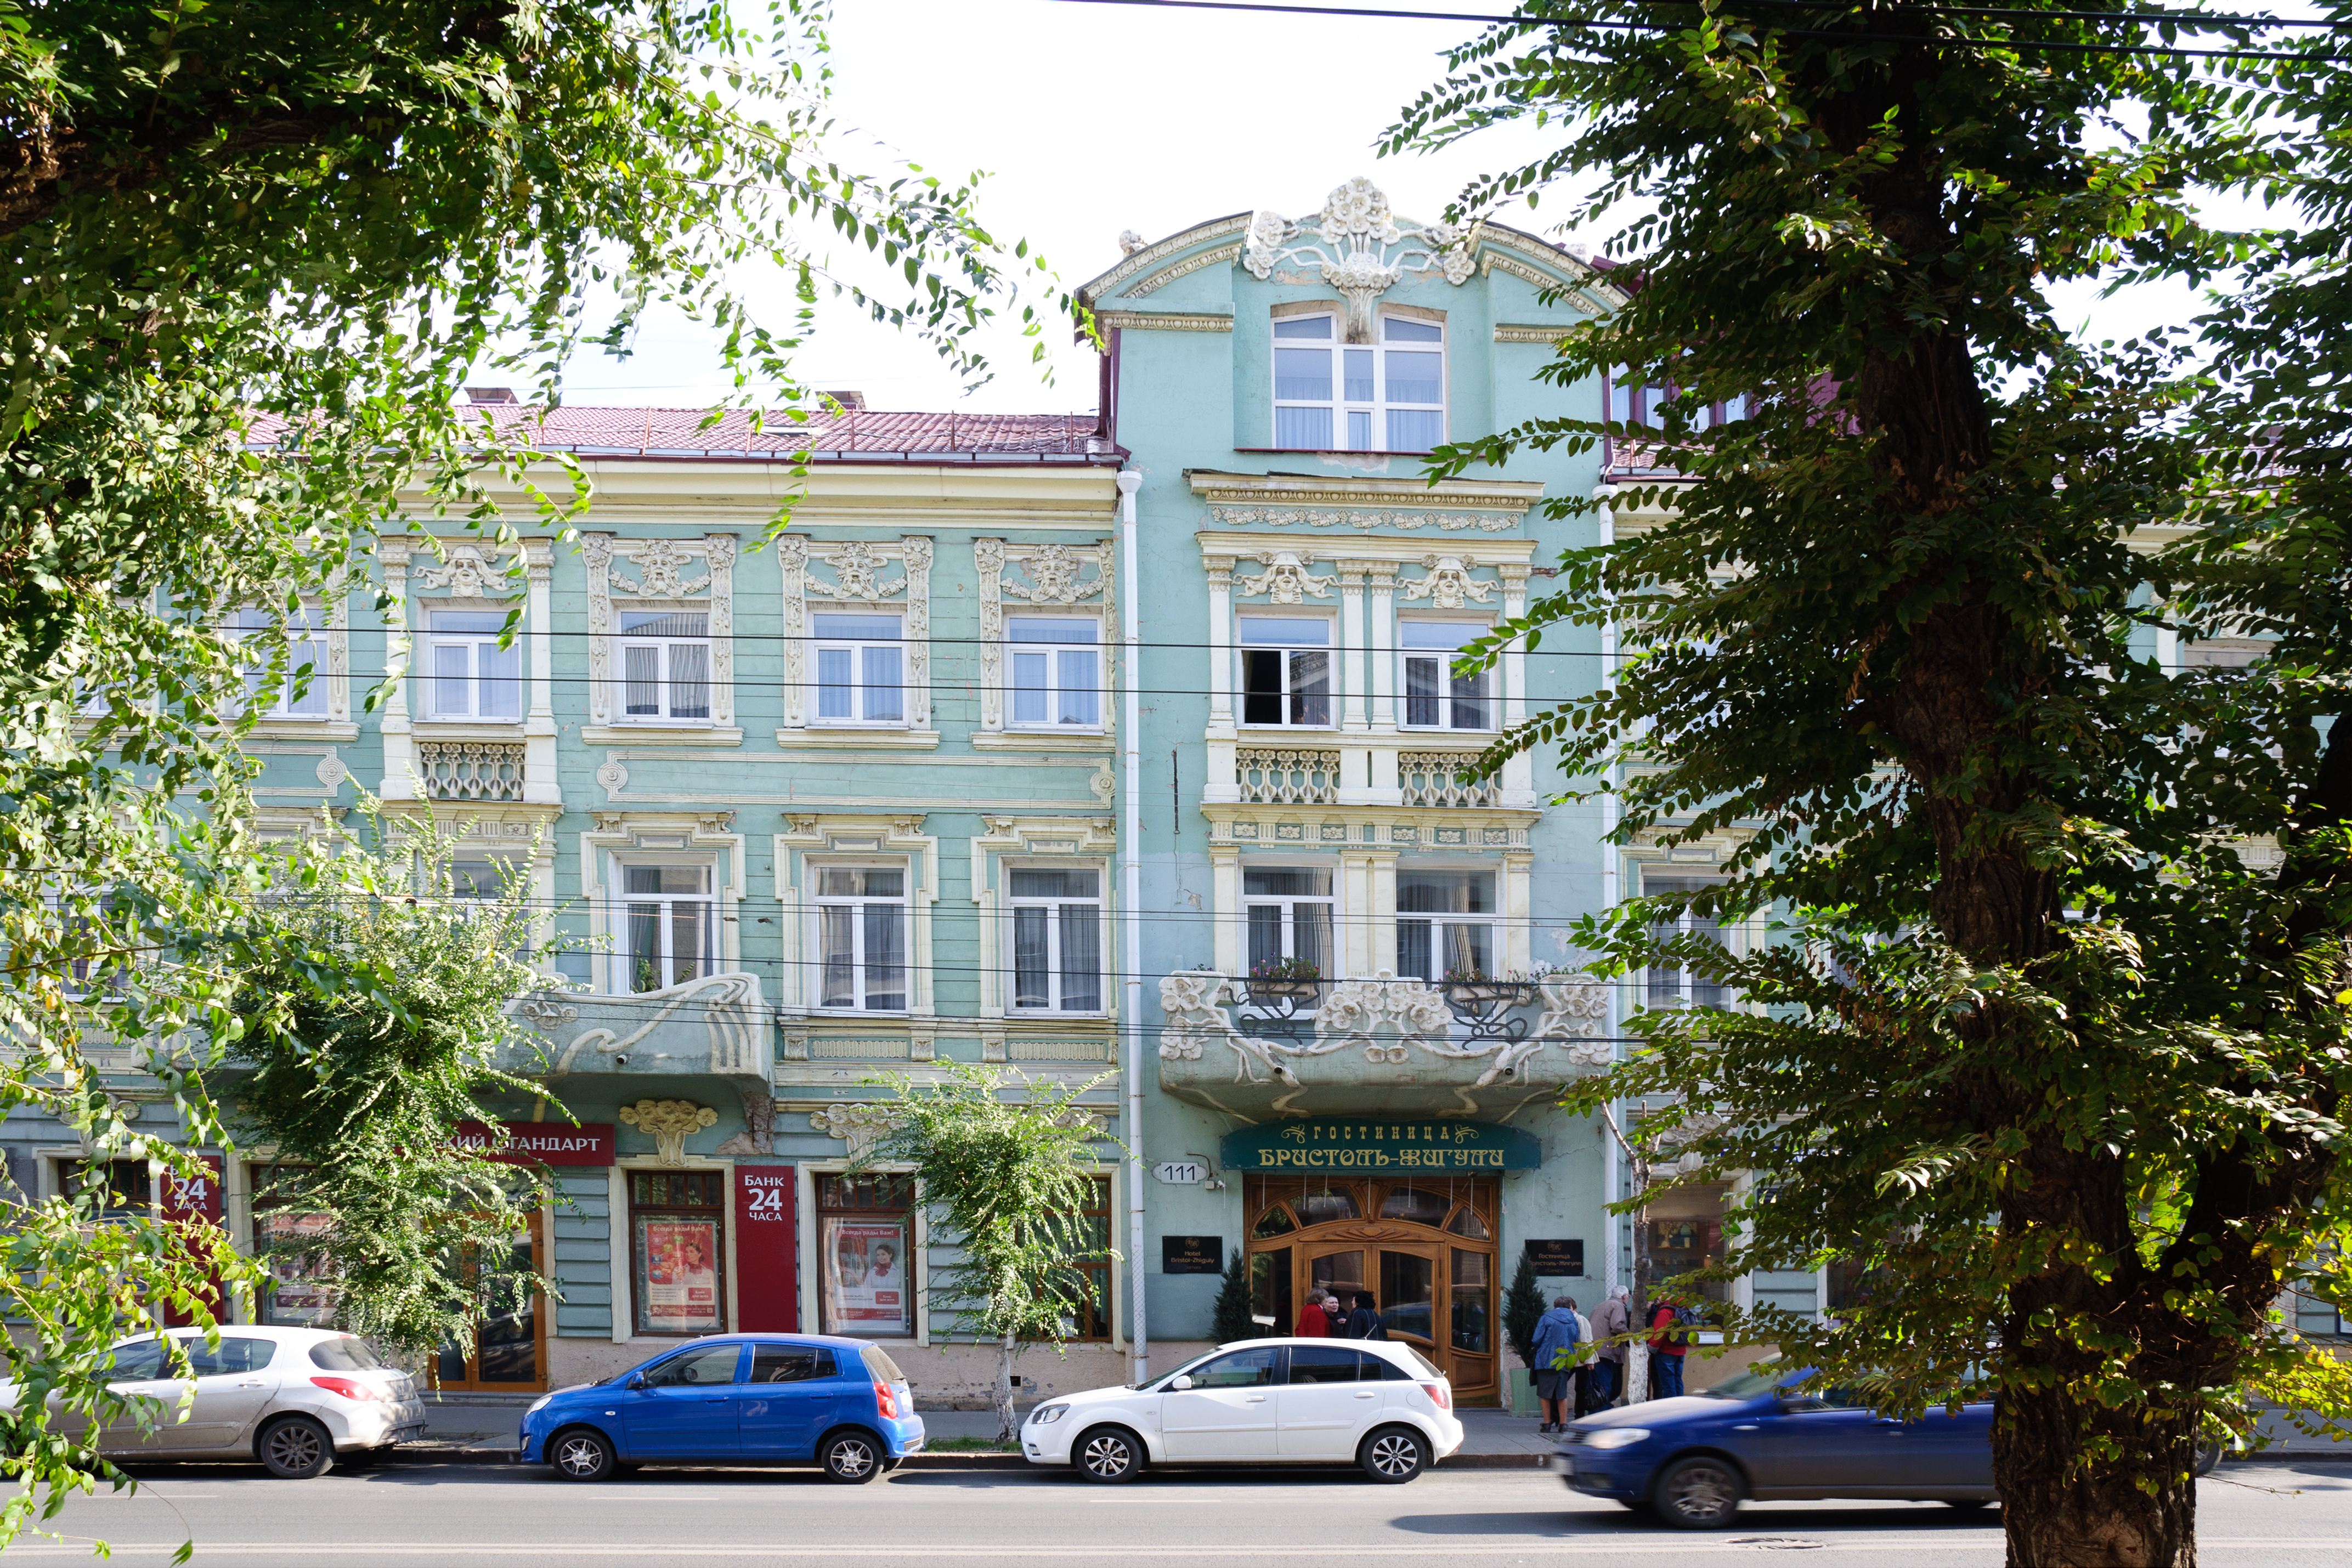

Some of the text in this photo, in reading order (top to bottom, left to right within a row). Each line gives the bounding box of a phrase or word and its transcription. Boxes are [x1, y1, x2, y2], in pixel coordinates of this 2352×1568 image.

[1314, 1126, 1449, 1141] ГОСТИНИЦА
[492, 1135, 600, 1151] СТАНДАРТ
[744, 1175, 784, 1186] БАНК
[1164, 1165, 1195, 1181] 111
[174, 1178, 207, 1200] 24
[174, 1201, 208, 1210] ЧАСА
[748, 1188, 783, 1211] 24
[749, 1212, 783, 1221] ЧАСА
